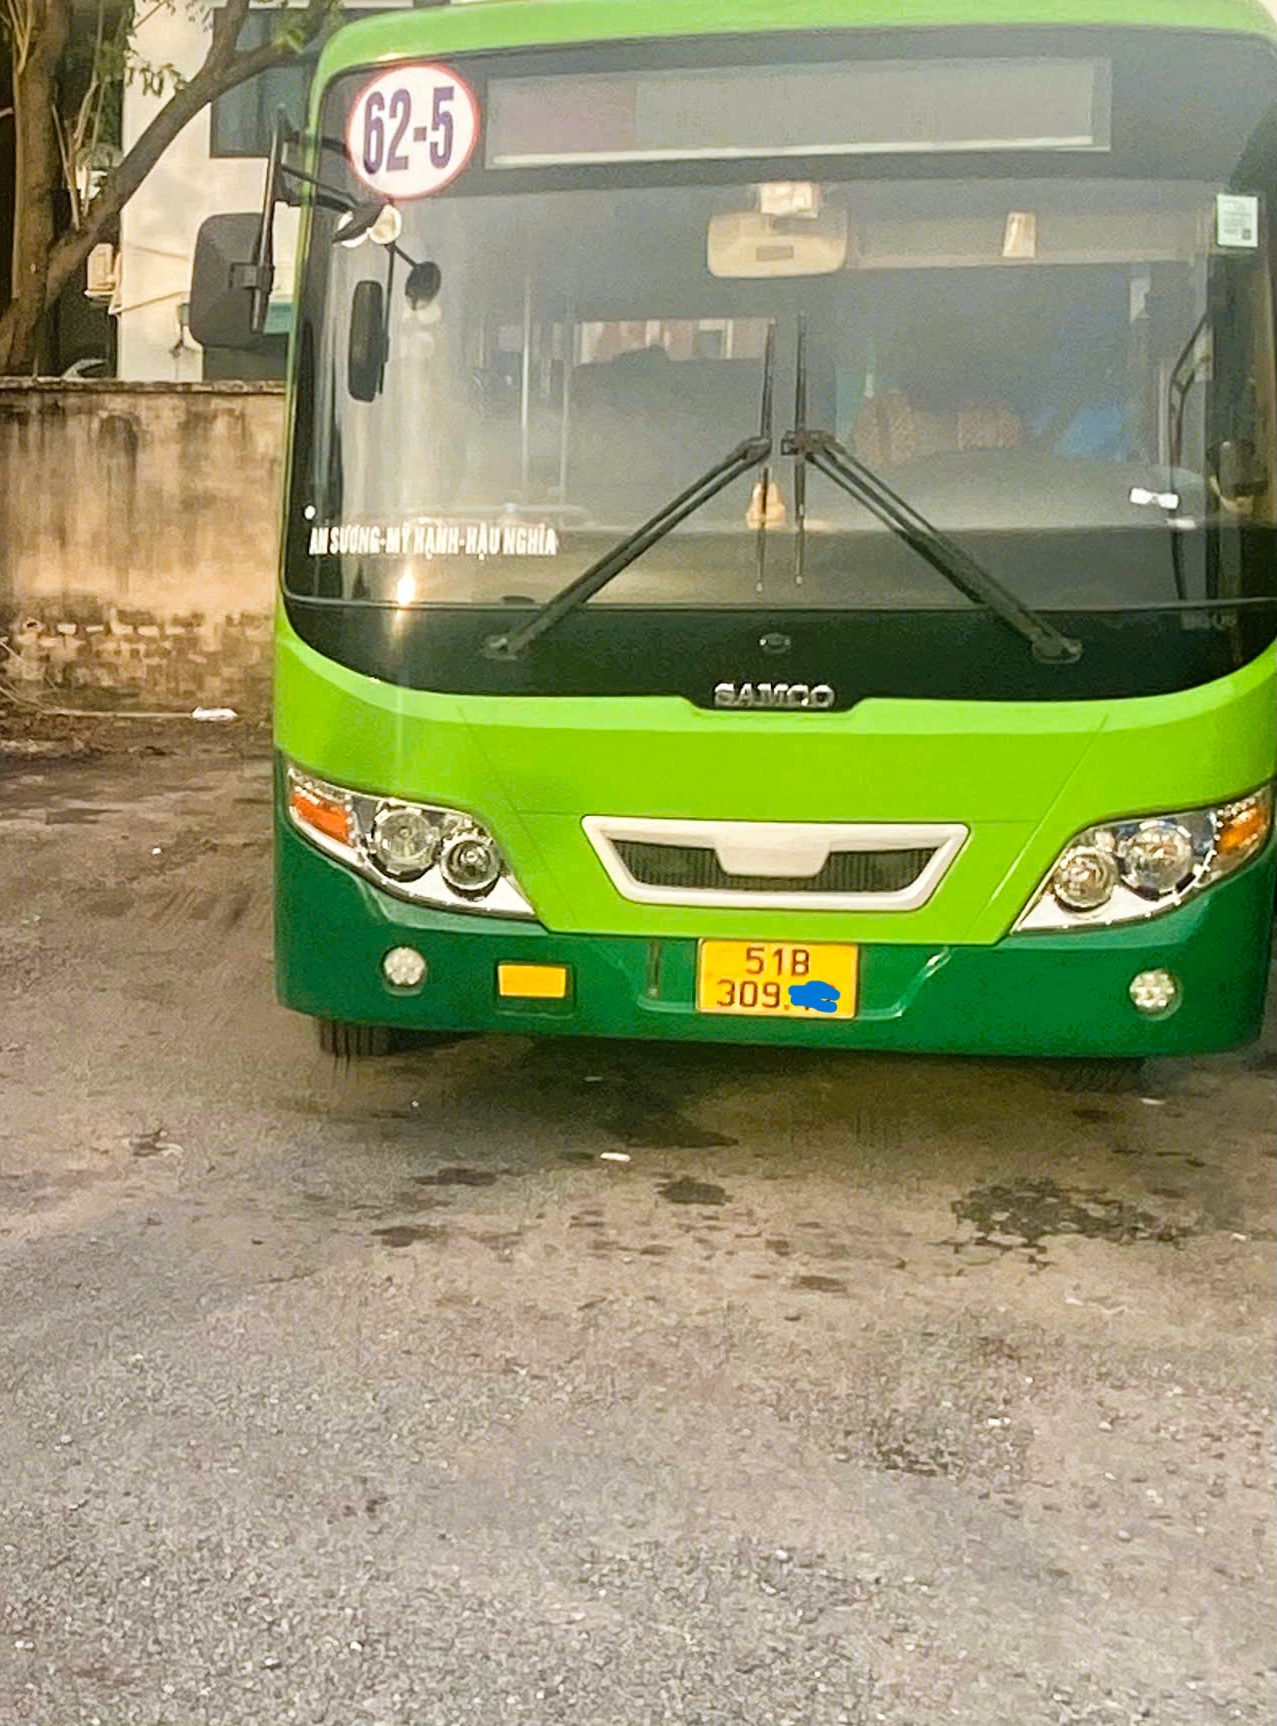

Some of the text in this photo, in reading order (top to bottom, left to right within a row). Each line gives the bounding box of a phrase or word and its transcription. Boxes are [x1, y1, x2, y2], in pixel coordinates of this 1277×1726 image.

[363, 86, 454, 175] 62-5
[309, 527, 328, 555] AN
[503, 522, 557, 555] NGHĨA
[714, 682, 835, 708] SAMCO
[745, 946, 810, 976] 51B
